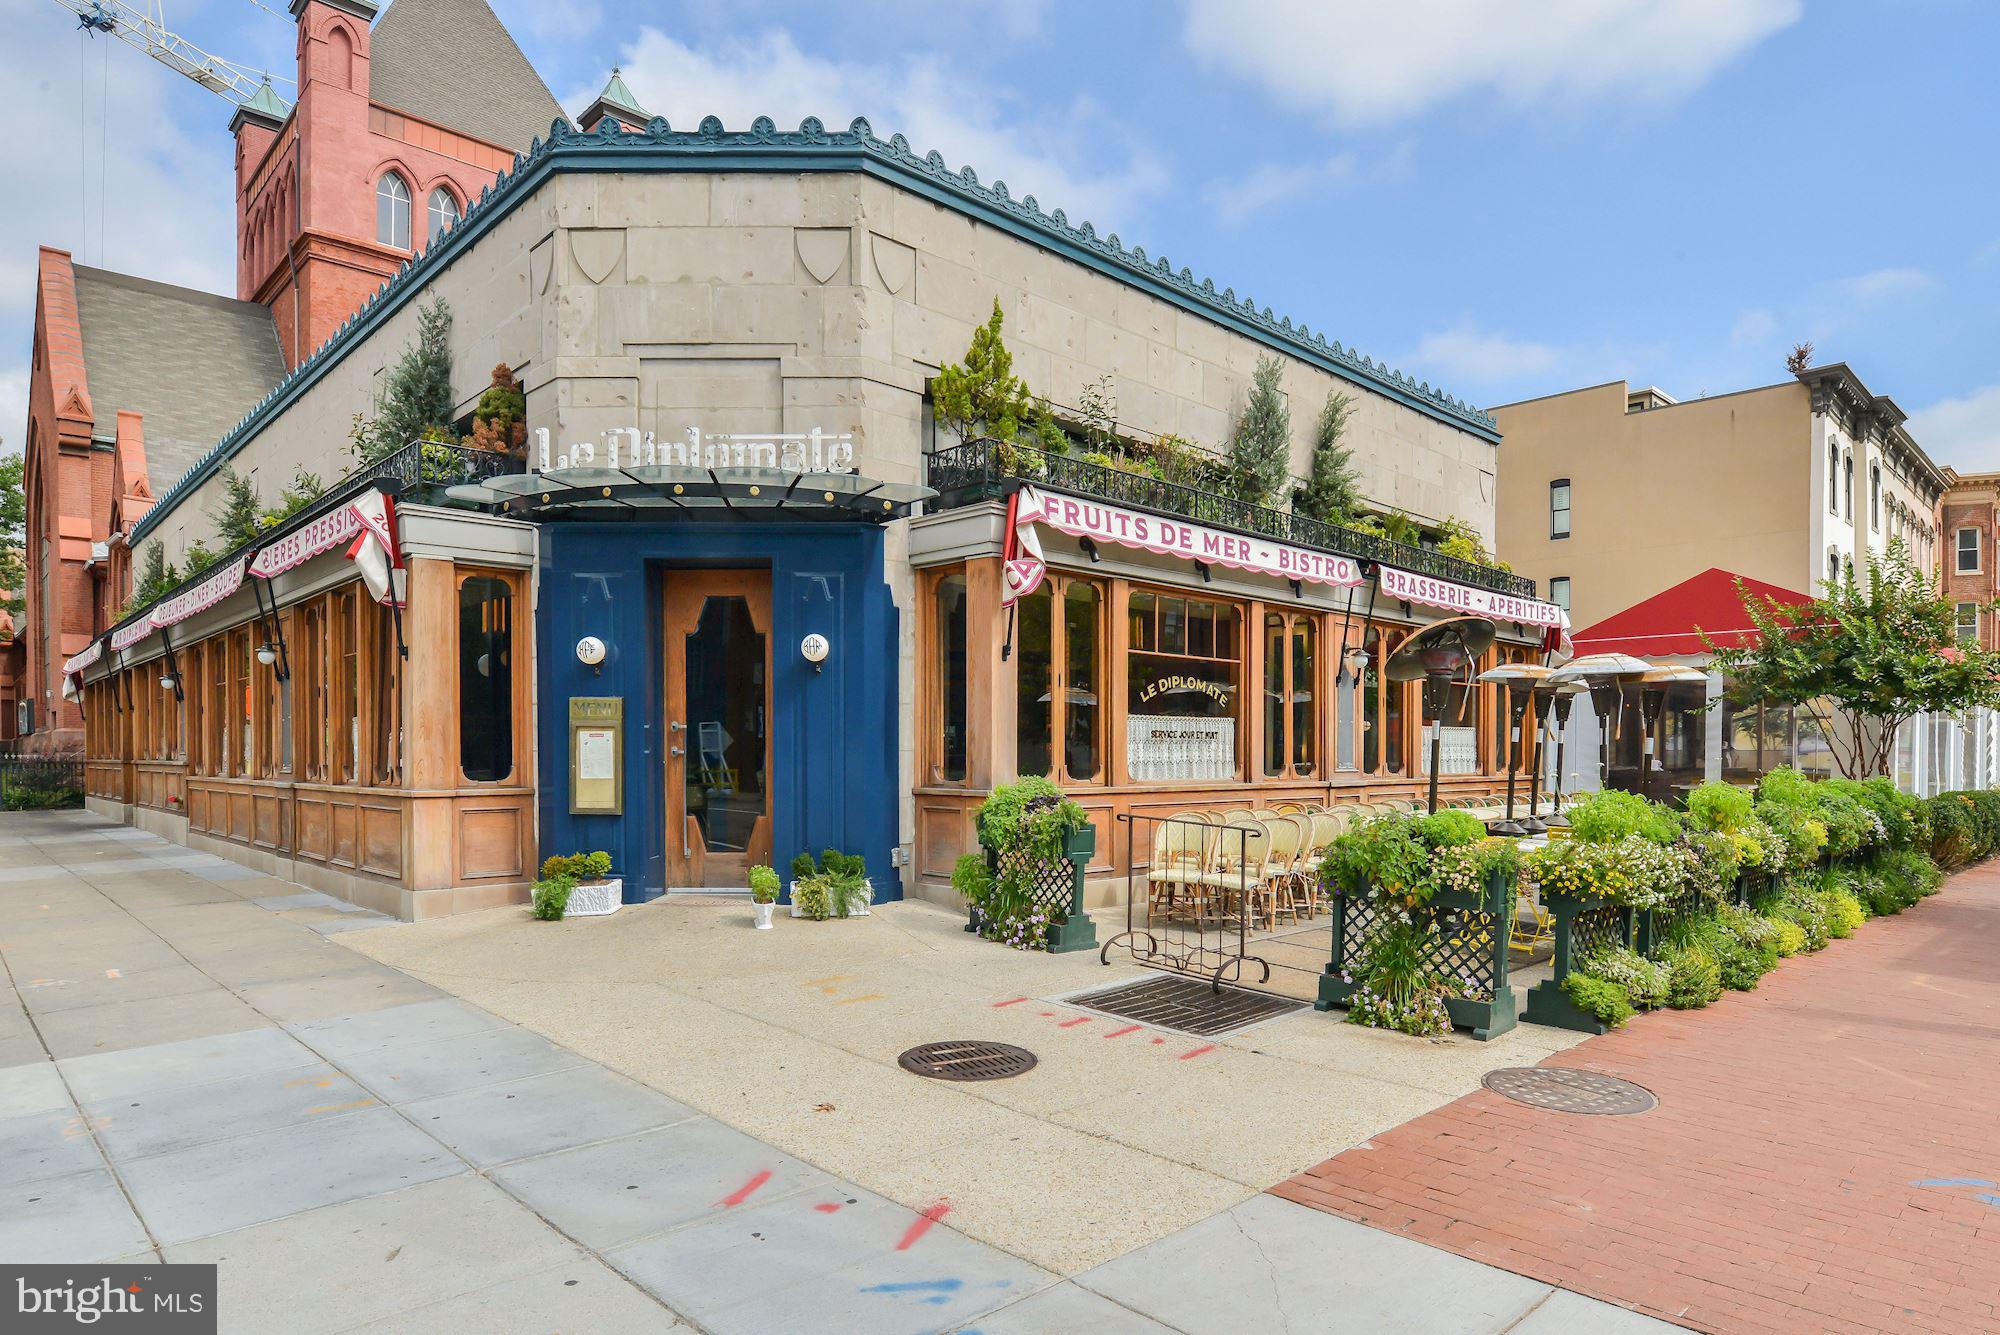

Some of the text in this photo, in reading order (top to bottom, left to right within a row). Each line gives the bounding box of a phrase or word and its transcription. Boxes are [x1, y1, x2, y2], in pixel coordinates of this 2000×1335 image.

[305, 507, 363, 550] PRESSIO
[1043, 495, 1149, 541] FRUITS
[1160, 521, 1193, 549] DE
[1203, 532, 1251, 561] MER
[1279, 548, 1349, 580] BISTRO
[1386, 571, 1471, 606] BRASSERIE
[1140, 676, 1228, 708] LE DIPLOMATE
[573, 702, 618, 717] MENU
[1150, 730, 1178, 739] SERVICE
[1178, 730, 1195, 739] JOUR
[1195, 731, 1204, 739] ET
